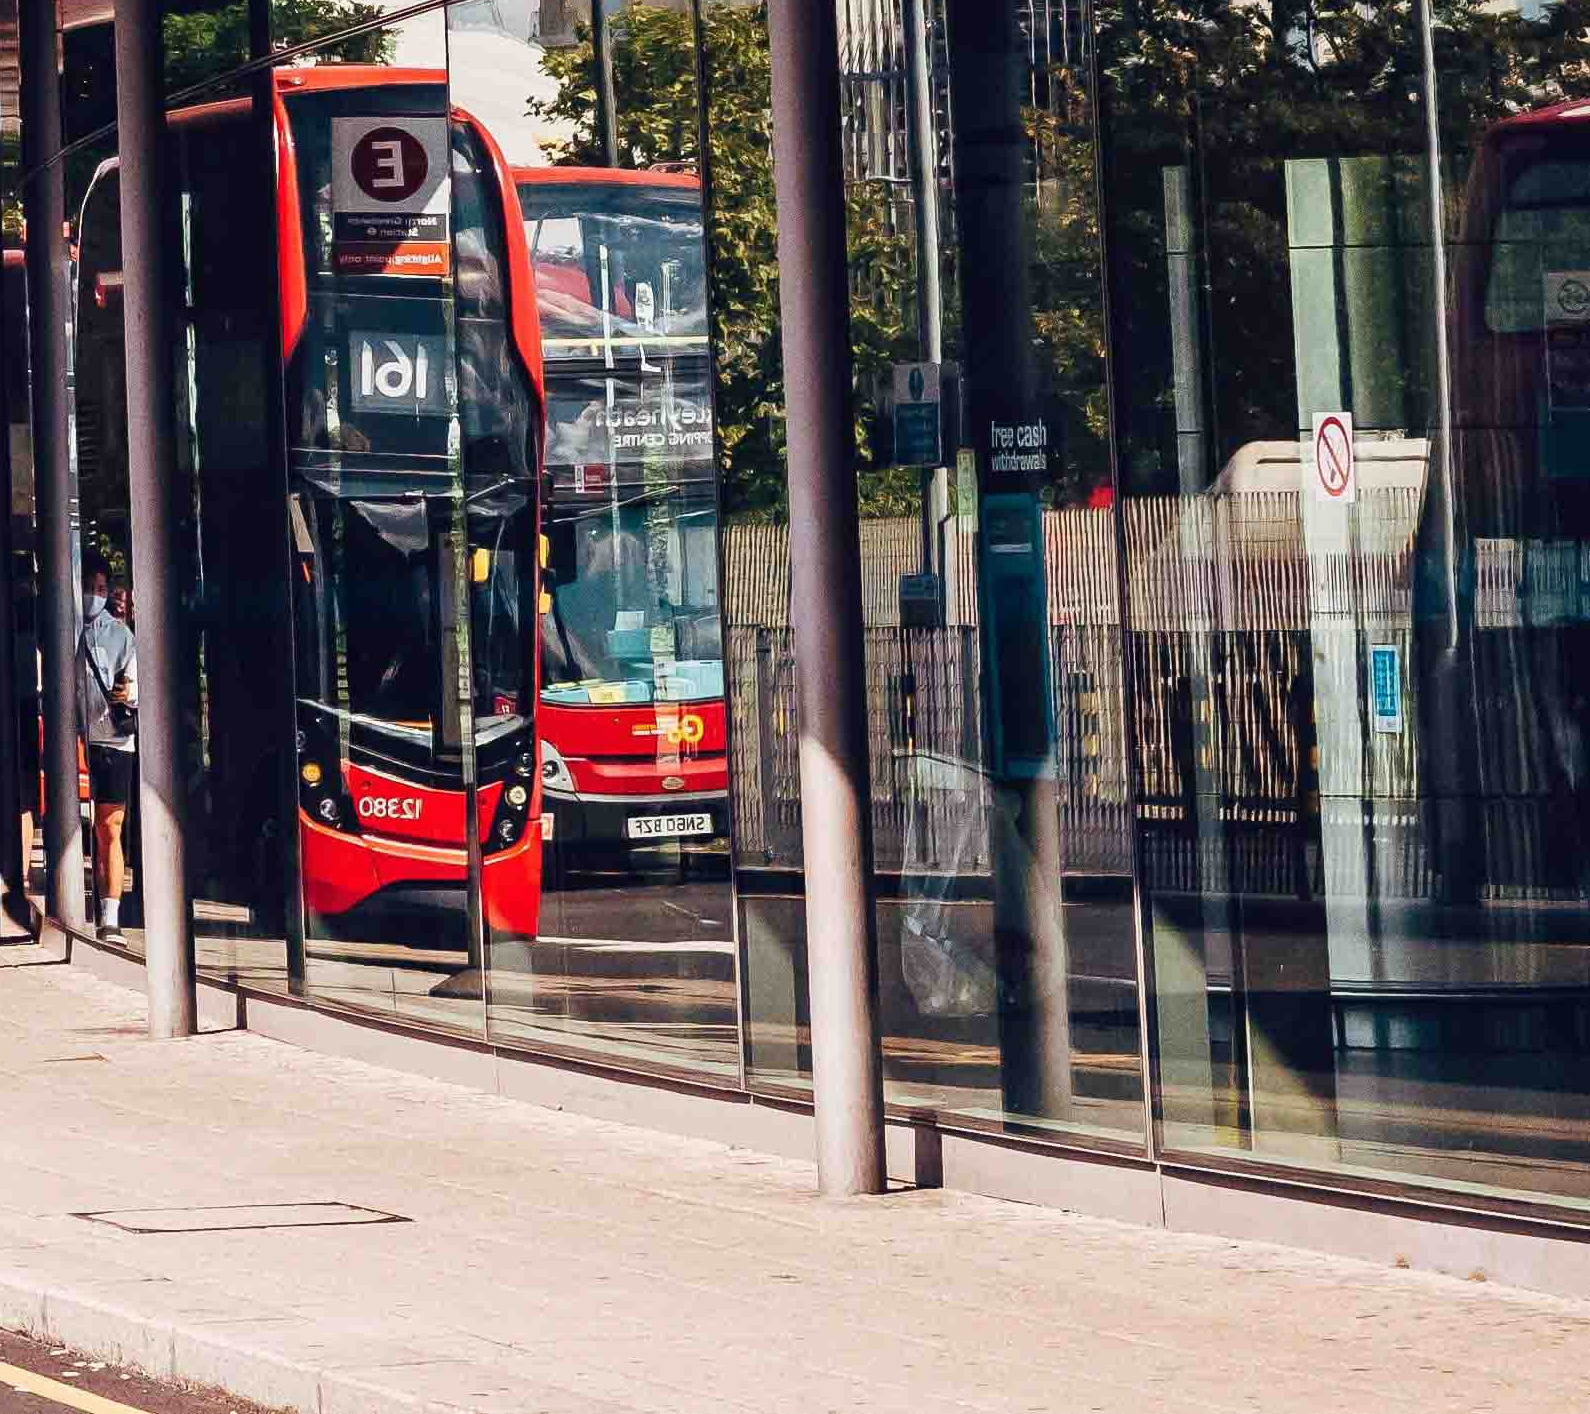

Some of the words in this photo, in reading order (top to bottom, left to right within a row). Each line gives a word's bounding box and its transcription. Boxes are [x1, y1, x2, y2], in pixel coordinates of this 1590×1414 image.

[991, 420, 1014, 449] free
[1017, 417, 1047, 447] cash
[991, 449, 1047, 471] withdrawals
